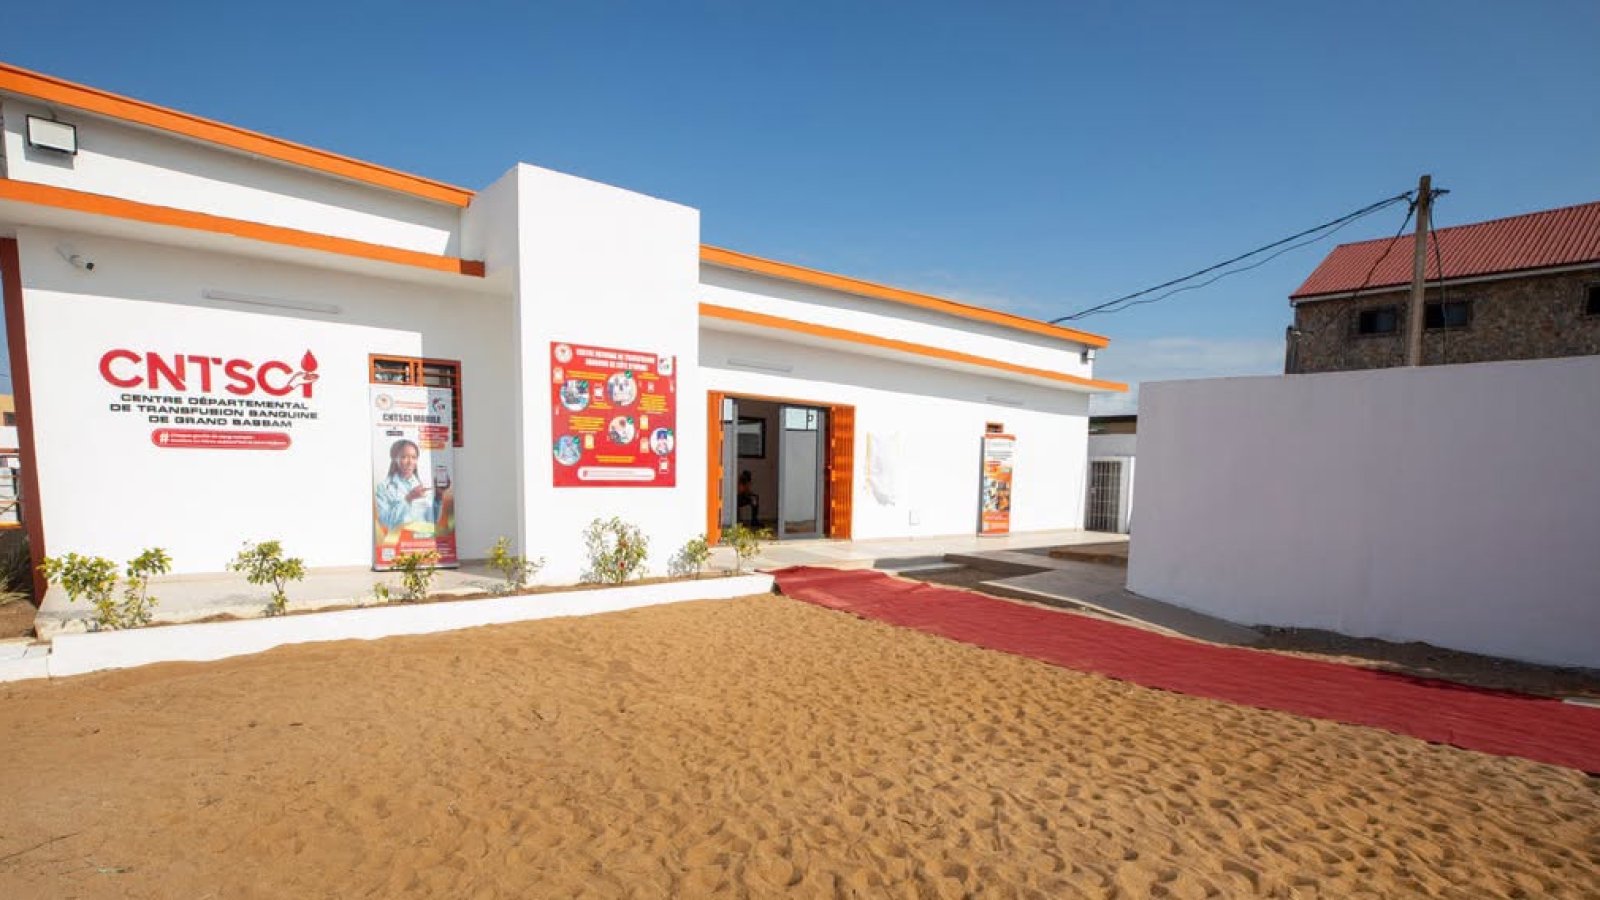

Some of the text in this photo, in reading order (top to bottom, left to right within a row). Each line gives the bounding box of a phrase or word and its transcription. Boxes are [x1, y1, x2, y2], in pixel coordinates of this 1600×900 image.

[121, 394, 308, 410] CENTRE DÉPARTEMENTAL
[110, 403, 318, 419] DE TRANSFUSION SANGUINE
[149, 414, 292, 428] DE GRAND BASSAM
